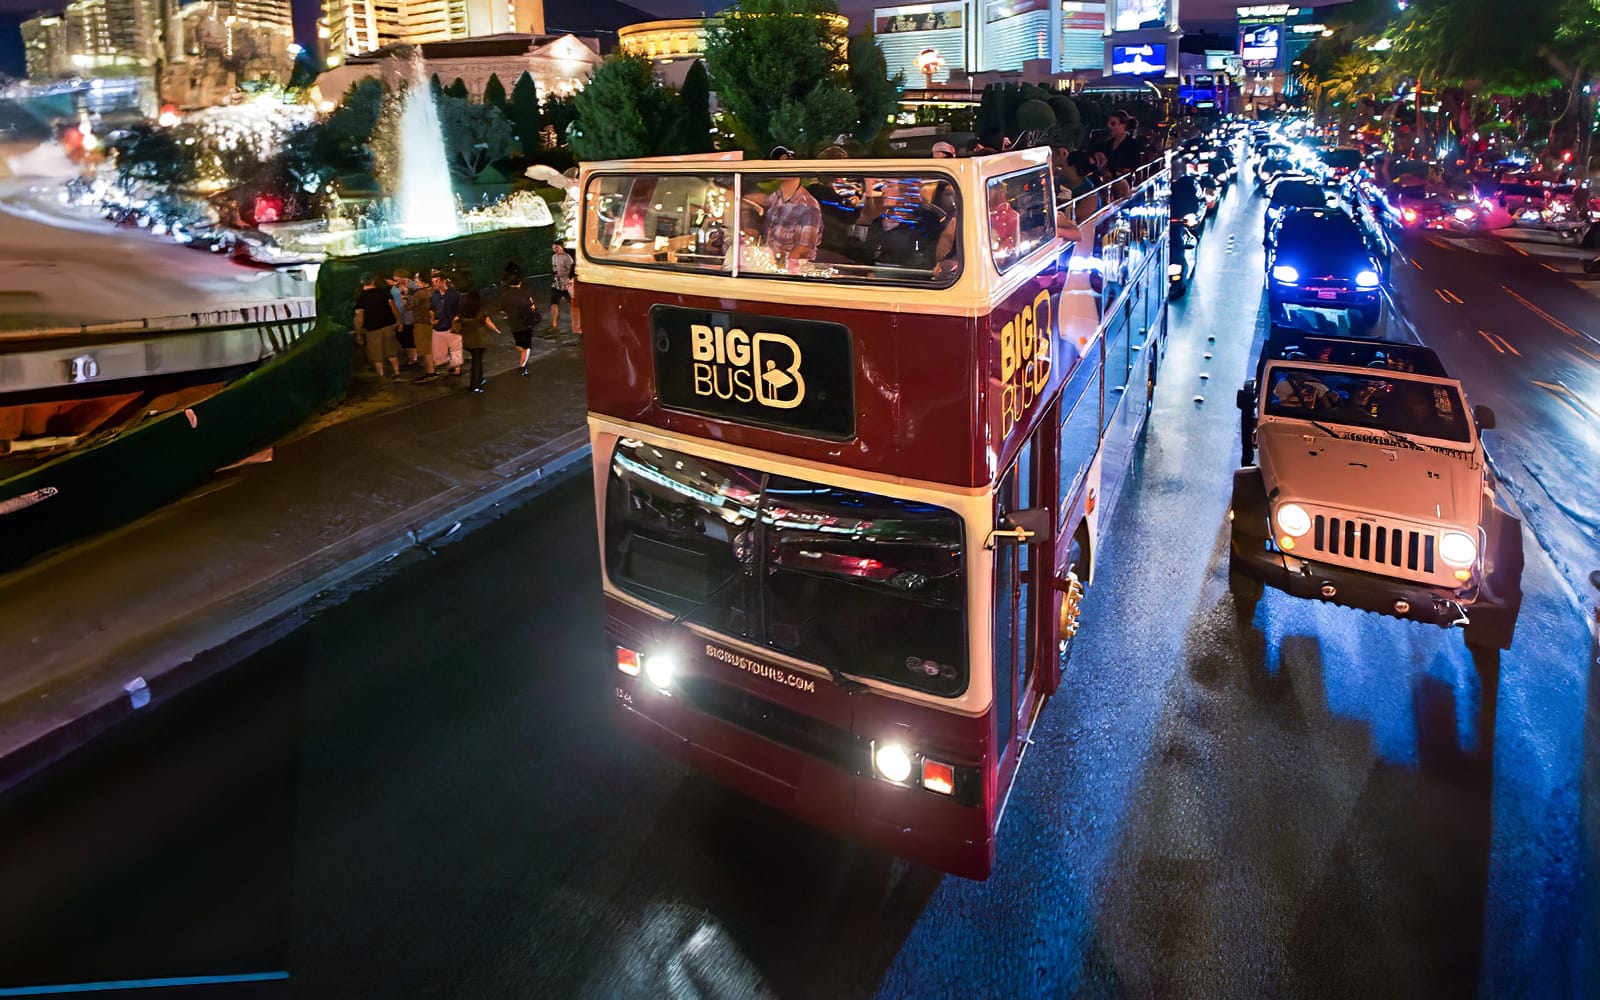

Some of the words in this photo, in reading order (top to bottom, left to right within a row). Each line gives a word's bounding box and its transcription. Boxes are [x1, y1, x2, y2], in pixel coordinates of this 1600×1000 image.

[691, 324, 751, 367] BIG
[1001, 305, 1032, 385] BIG
[694, 362, 754, 403] BUS
[1002, 360, 1034, 441] BUS
[705, 644, 815, 693] BIGBUSTOURS.COM
